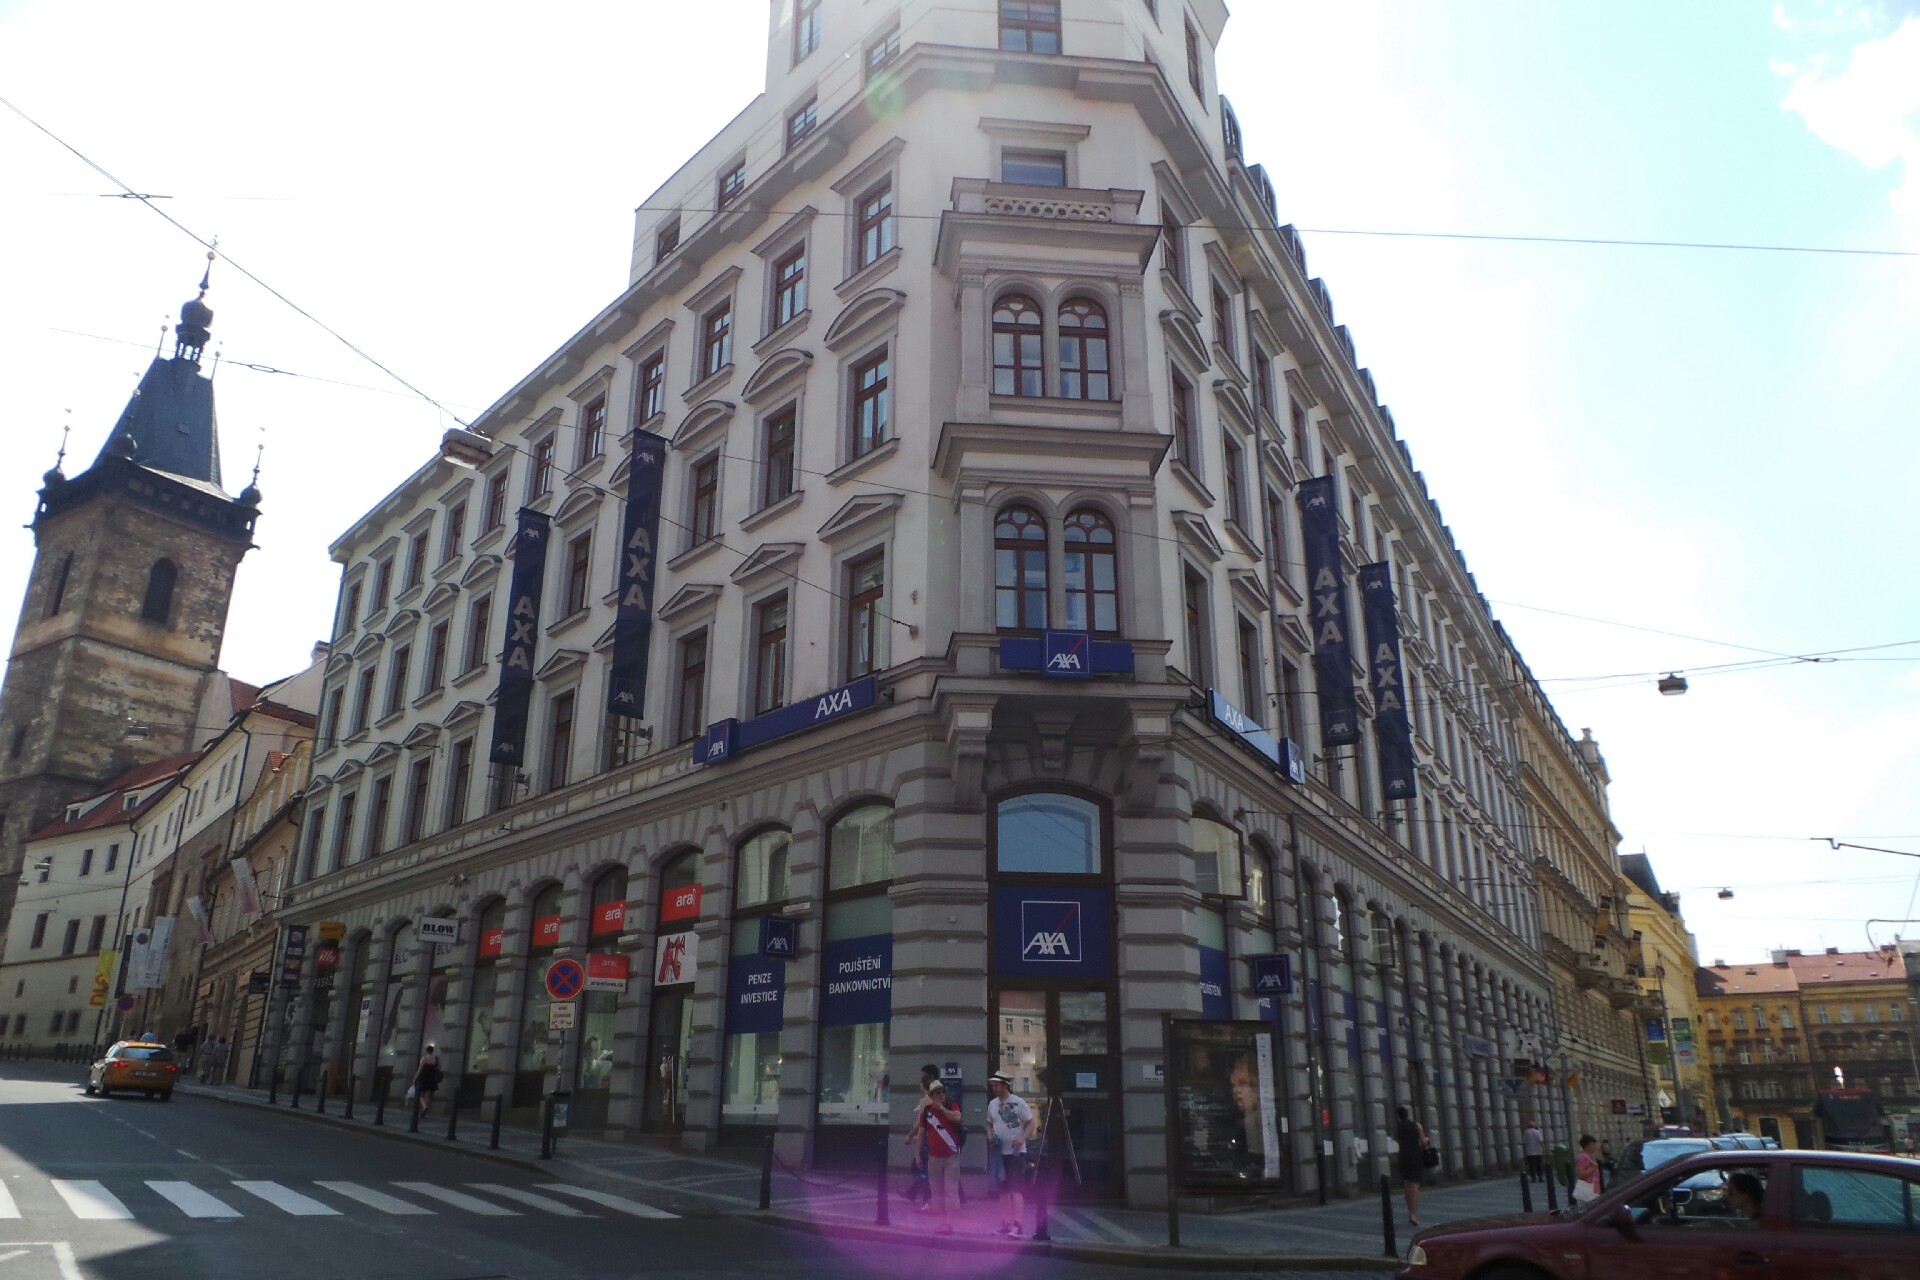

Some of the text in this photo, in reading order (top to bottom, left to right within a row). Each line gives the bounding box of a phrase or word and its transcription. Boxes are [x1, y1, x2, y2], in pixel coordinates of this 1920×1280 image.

[622, 527, 653, 611] AXA
[1314, 566, 1344, 645] AXA
[507, 595, 535, 670] AXA
[1047, 653, 1081, 669] AXA
[1375, 643, 1402, 709] AXA
[815, 688, 852, 719] AXA
[1225, 703, 1244, 732] AXA
[708, 740, 724, 757] AXA
[676, 893, 693, 908] ara
[605, 908, 620, 921] ara
[423, 923, 455, 934] BLOW
[544, 921, 557, 934] ara
[489, 934, 502, 946] ara
[767, 937, 789, 951] AXA
[1023, 932, 1071, 955] AXA
[839, 955, 882, 974] POJIŠTĚNÍ
[748, 972, 772, 985] PENZE
[829, 974, 892, 995] BANKOVNICTVÍ
[1258, 974, 1281, 988] AXA
[741, 990, 778, 1005] INVESTICE
